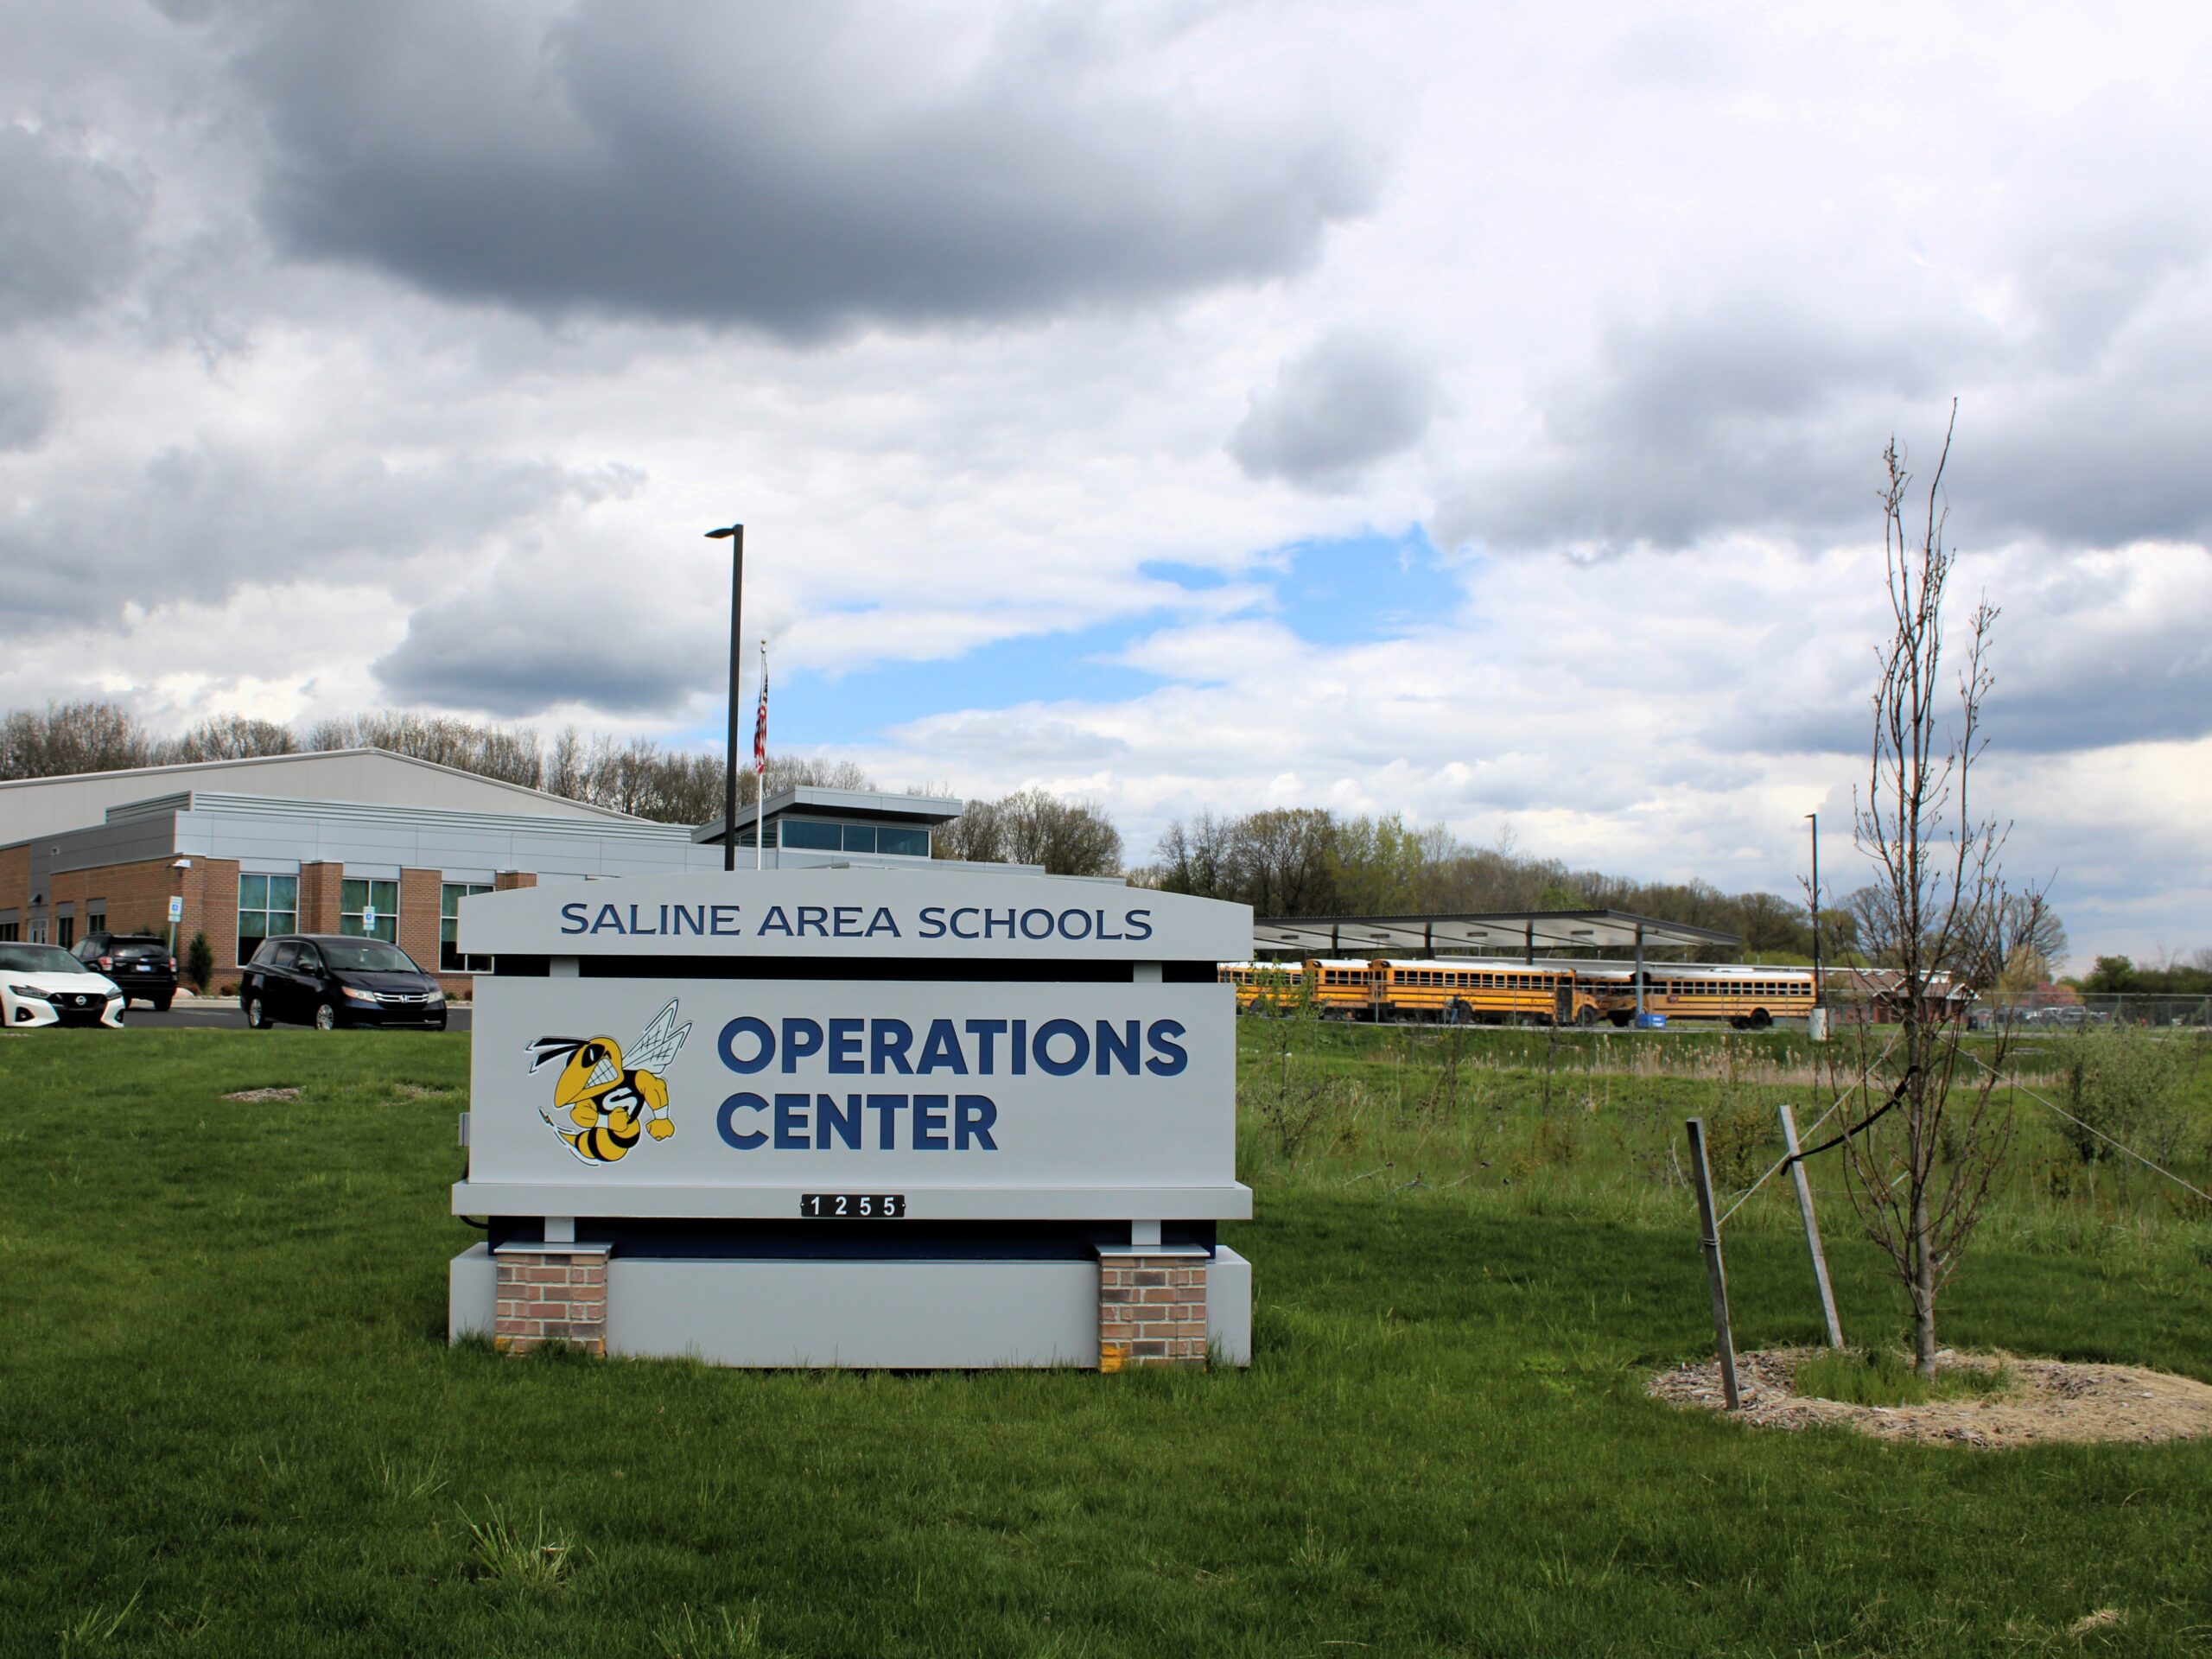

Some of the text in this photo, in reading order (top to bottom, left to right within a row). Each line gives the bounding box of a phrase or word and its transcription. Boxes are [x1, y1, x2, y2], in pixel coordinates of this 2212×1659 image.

[560, 902, 1153, 941] SALINE AREA SCHOOLS
[717, 1015, 1188, 1077] OPERATIONS
[602, 1087, 638, 1119] S
[716, 1092, 999, 1151] CENTER
[810, 1196, 895, 1216] 1255
